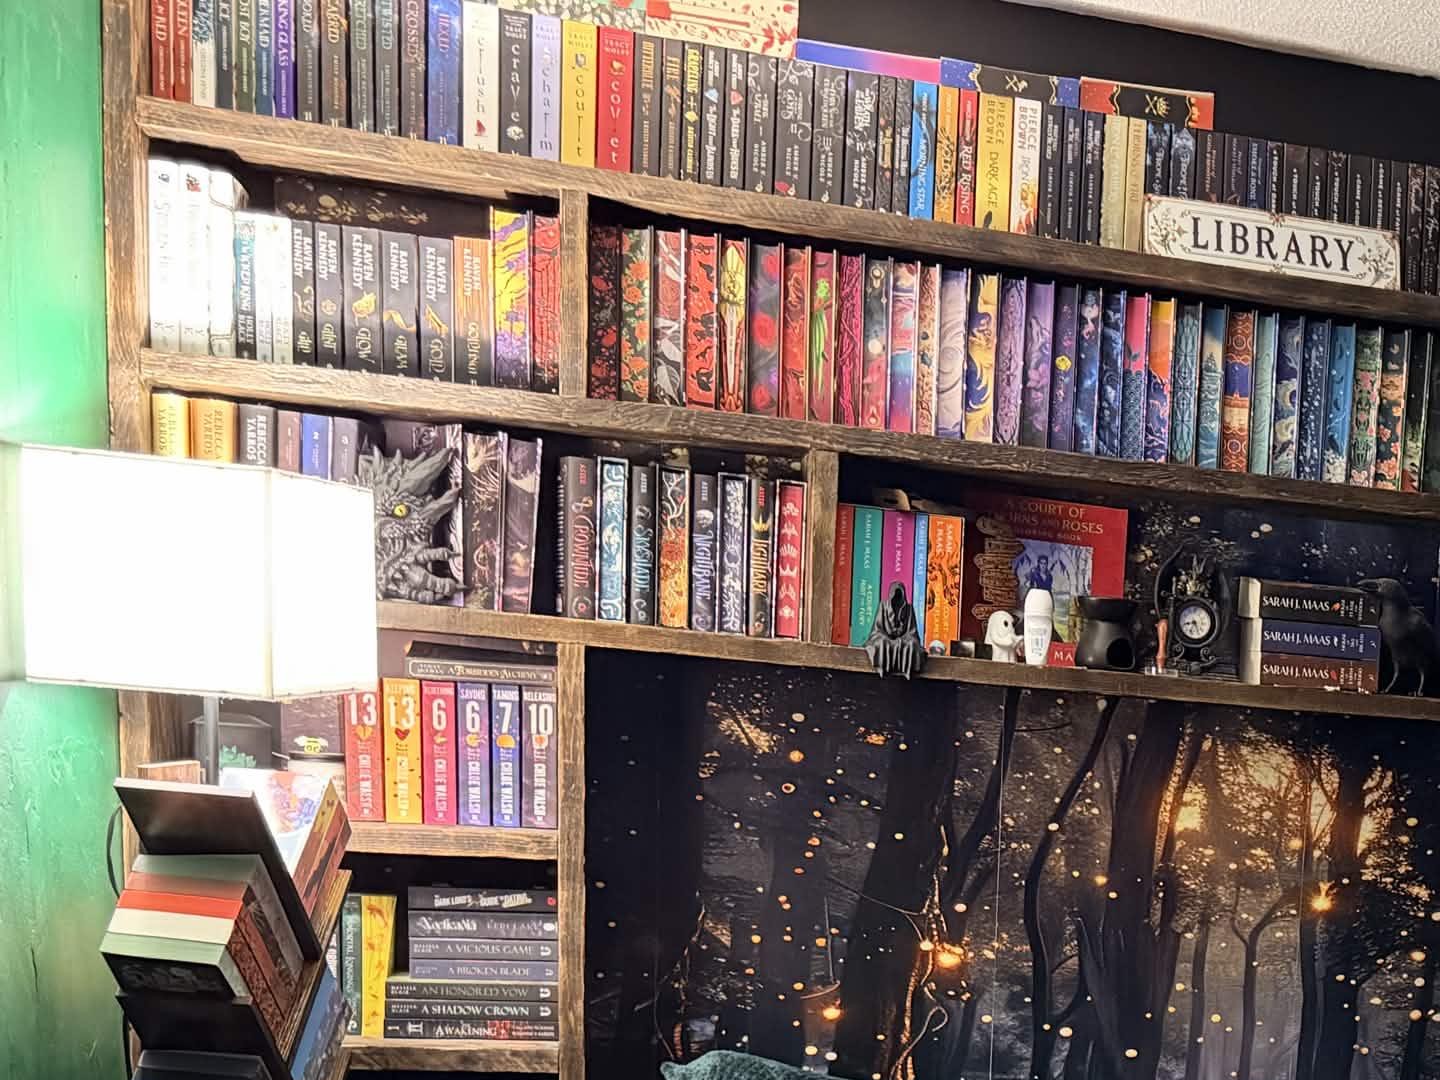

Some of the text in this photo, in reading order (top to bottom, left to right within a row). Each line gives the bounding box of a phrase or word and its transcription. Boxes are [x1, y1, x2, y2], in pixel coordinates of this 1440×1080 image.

[154, 16, 167, 42] RED
[240, 22, 251, 45] BOY
[278, 32, 289, 66] GLASS
[511, 46, 521, 122] crave
[665, 56, 680, 82] FIRE
[540, 70, 554, 151] charm
[575, 76, 586, 158] court
[609, 82, 623, 164] covet
[985, 99, 997, 144] BROWN
[994, 101, 1006, 145] PIERCE
[1017, 105, 1029, 149] BROWN
[1027, 107, 1039, 152] PIERCE
[915, 138, 929, 210] MORNING STAR
[959, 145, 973, 214] RED RISING
[986, 151, 1000, 208] DARK AGE
[1020, 155, 1031, 181] IRON
[1272, 156, 1280, 182] TOUCH
[1377, 167, 1385, 189] GAME
[1291, 173, 1299, 200] TOUCH
[1355, 178, 1363, 200] GAME
[293, 227, 304, 280] KENNEDY
[303, 236, 313, 271] RAVEN
[318, 230, 330, 281] KENNEDY
[327, 239, 338, 273] RAVEN
[1190, 214, 1357, 273] LIBRARY
[351, 233, 364, 290] KENNEDY
[364, 243, 375, 281] RAVEN
[389, 241, 400, 291] KENNEDY
[399, 249, 409, 284] RAVEN
[425, 246, 437, 302] KENNEDY
[436, 255, 447, 293] RAVEN
[463, 248, 473, 298] KENNEDY
[472, 256, 481, 290] RAVEN
[240, 285, 252, 312] KING
[237, 314, 247, 343] BLACK
[246, 315, 254, 344] HOLLY
[355, 327, 376, 364] GLOW
[157, 408, 168, 451] YARROS
[202, 411, 214, 455] YARROS
[213, 408, 225, 460] REBECCA
[246, 416, 257, 460] YARROS
[255, 415, 267, 465] REBECCA
[579, 463, 588, 485] ASTER
[640, 472, 648, 494] ASTER
[701, 480, 709, 501] ASTER
[1023, 501, 1087, 519] COURT OF
[1062, 518, 1105, 535] ROSES
[572, 514, 595, 590] CROWNTIDE
[838, 511, 848, 567] SARAH MAAS
[862, 513, 873, 569] SARAH MAAS
[894, 516, 904, 573] SARAH MAAS
[917, 519, 927, 576] SARAH MAAS
[935, 528, 946, 555] MAAS
[944, 523, 954, 555] SARAH
[632, 524, 654, 594] SKYSHADE
[691, 530, 716, 601] NIGHTBANE
[751, 537, 772, 600] LIGHTLARK
[1262, 595, 1294, 611] SARAH
[1303, 598, 1330, 613] MAAS
[1053, 649, 1074, 662] MA
[1262, 630, 1295, 645] SARAH
[1304, 633, 1331, 648] MAAS
[1262, 662, 1293, 679] SARAH
[1302, 666, 1330, 682] MAAS
[346, 692, 378, 727] 13
[459, 687, 487, 699] SAVING
[492, 688, 519, 699] TAMING
[386, 695, 416, 729] 13
[431, 698, 448, 730] 6
[465, 700, 481, 733] 6
[498, 701, 513, 736] 7
[528, 703, 554, 736] 10
[434, 758, 447, 811] CHLOE WALSH
[467, 761, 480, 814] CHLOE WALSH
[501, 761, 513, 814] CHLOE WALSH
[534, 762, 546, 816] CHLOE WALSH
[434, 896, 452, 908] DARK
[455, 945, 500, 956] VICIOUS
[502, 945, 534, 957] GAME
[457, 967, 498, 977] BROKEN
[500, 968, 530, 977] BLADE
[421, 986, 529, 998] AN HONORED VOW
[431, 1006, 483, 1018] SHADOW
[484, 1006, 530, 1019] CROWN
[434, 1021, 498, 1037] AWAKENING
